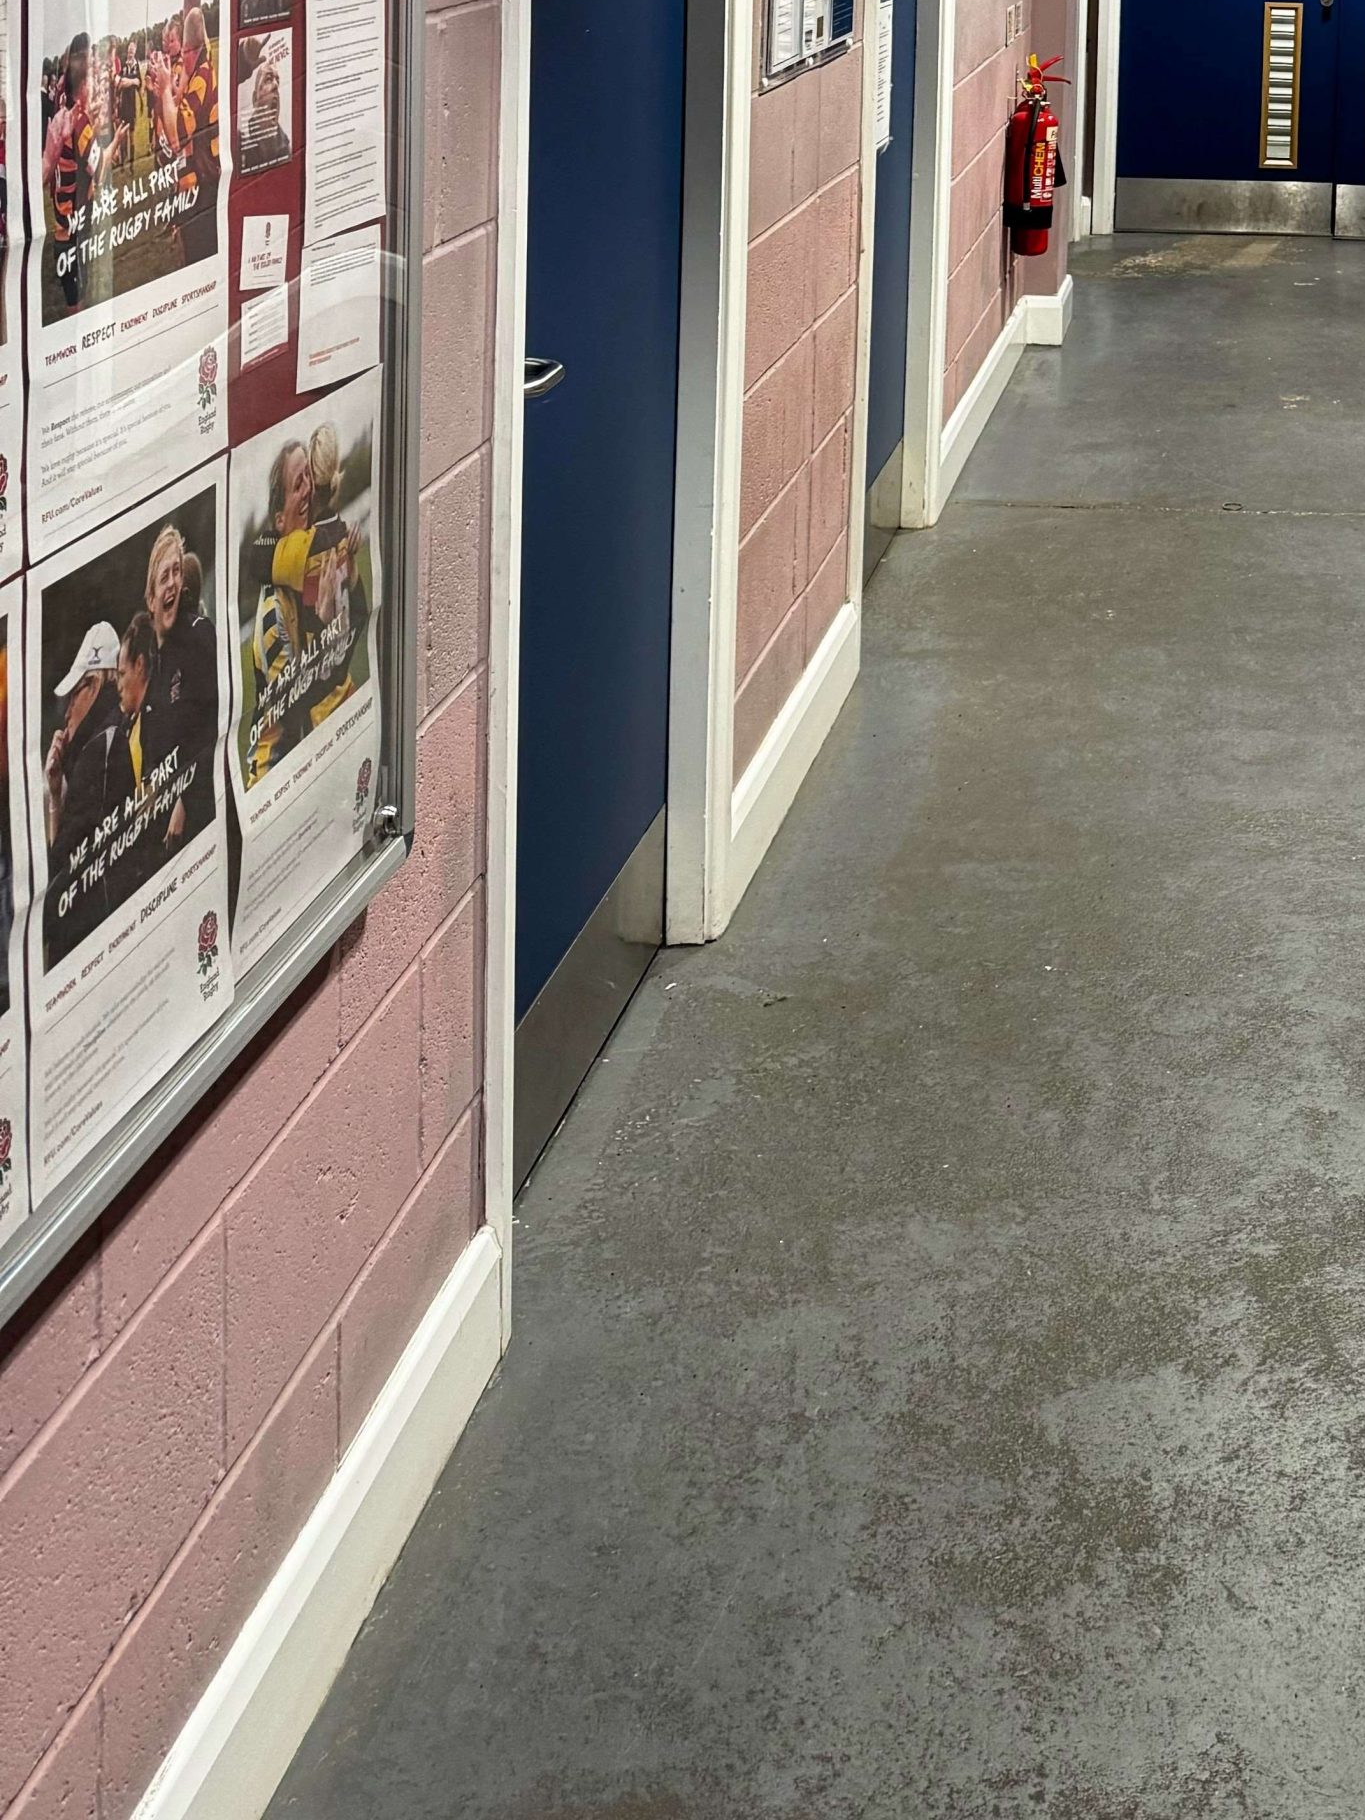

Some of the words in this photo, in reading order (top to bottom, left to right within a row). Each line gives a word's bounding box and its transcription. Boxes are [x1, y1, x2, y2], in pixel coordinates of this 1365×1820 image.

[56, 245, 77, 278] OF
[79, 230, 106, 265] THE
[108, 208, 151, 250] RUGBY
[153, 186, 199, 226] FAMILY
[67, 205, 86, 236] WE
[90, 187, 119, 225] ARE
[121, 178, 148, 208] ALL
[148, 158, 182, 194] PART
[45, 345, 77, 367] TEAMWORK
[81, 322, 116, 349] RESPECT
[152, 299, 178, 319] DISCIPLINE
[181, 280, 217, 304] SPORTSMANSHIP
[198, 408, 217, 426] England
[200, 421, 215, 435] Rugby
[41, 484, 103, 524] RFU.com/CoreValues
[250, 719, 266, 745] OF
[266, 695, 287, 728] THE
[288, 662, 320, 709] RUGBY
[258, 688, 273, 710] WE
[276, 657, 296, 692] ARE
[300, 640, 319, 670] ALL
[320, 613, 343, 649] PART
[335, 697, 373, 741] SPORTSMANSHIP
[58, 880, 78, 918] OF
[81, 850, 107, 894] THE
[110, 808, 150, 867] RUGBY
[153, 762, 198, 820] FAMILY
[69, 837, 88, 874] WE
[92, 806, 119, 852] ARE
[124, 777, 149, 818] ALL
[150, 745, 180, 791] PART
[45, 977, 77, 1012] TEAMWORK
[140, 877, 179, 924] DISCIPLINE
